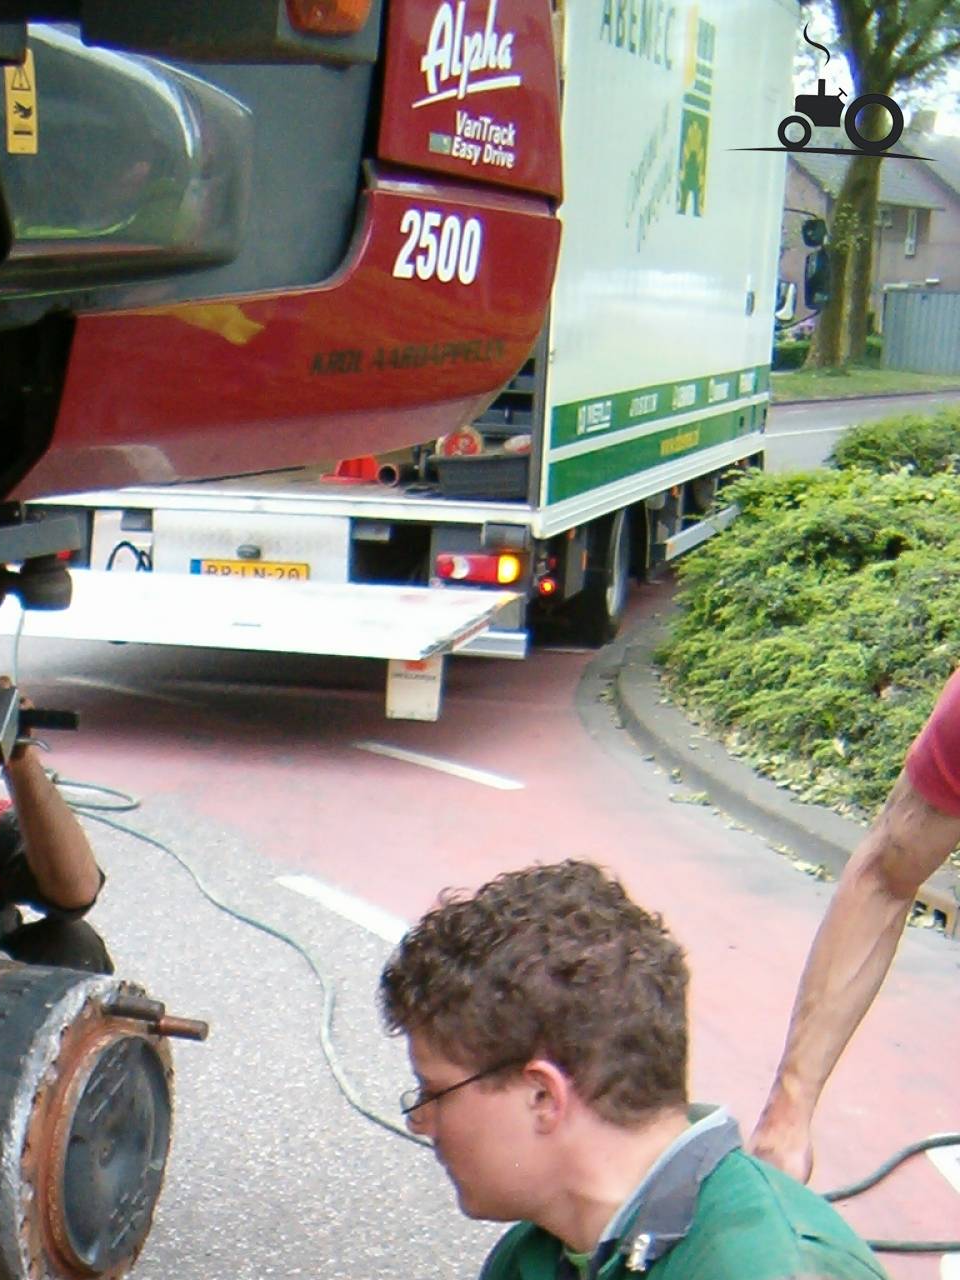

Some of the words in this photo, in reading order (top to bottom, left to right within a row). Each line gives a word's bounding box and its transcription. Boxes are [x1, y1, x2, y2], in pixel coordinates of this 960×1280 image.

[420, 0, 515, 99] Alpha
[452, 136, 481, 166] Easy
[483, 144, 515, 169] Drive
[392, 209, 482, 285] 2500
